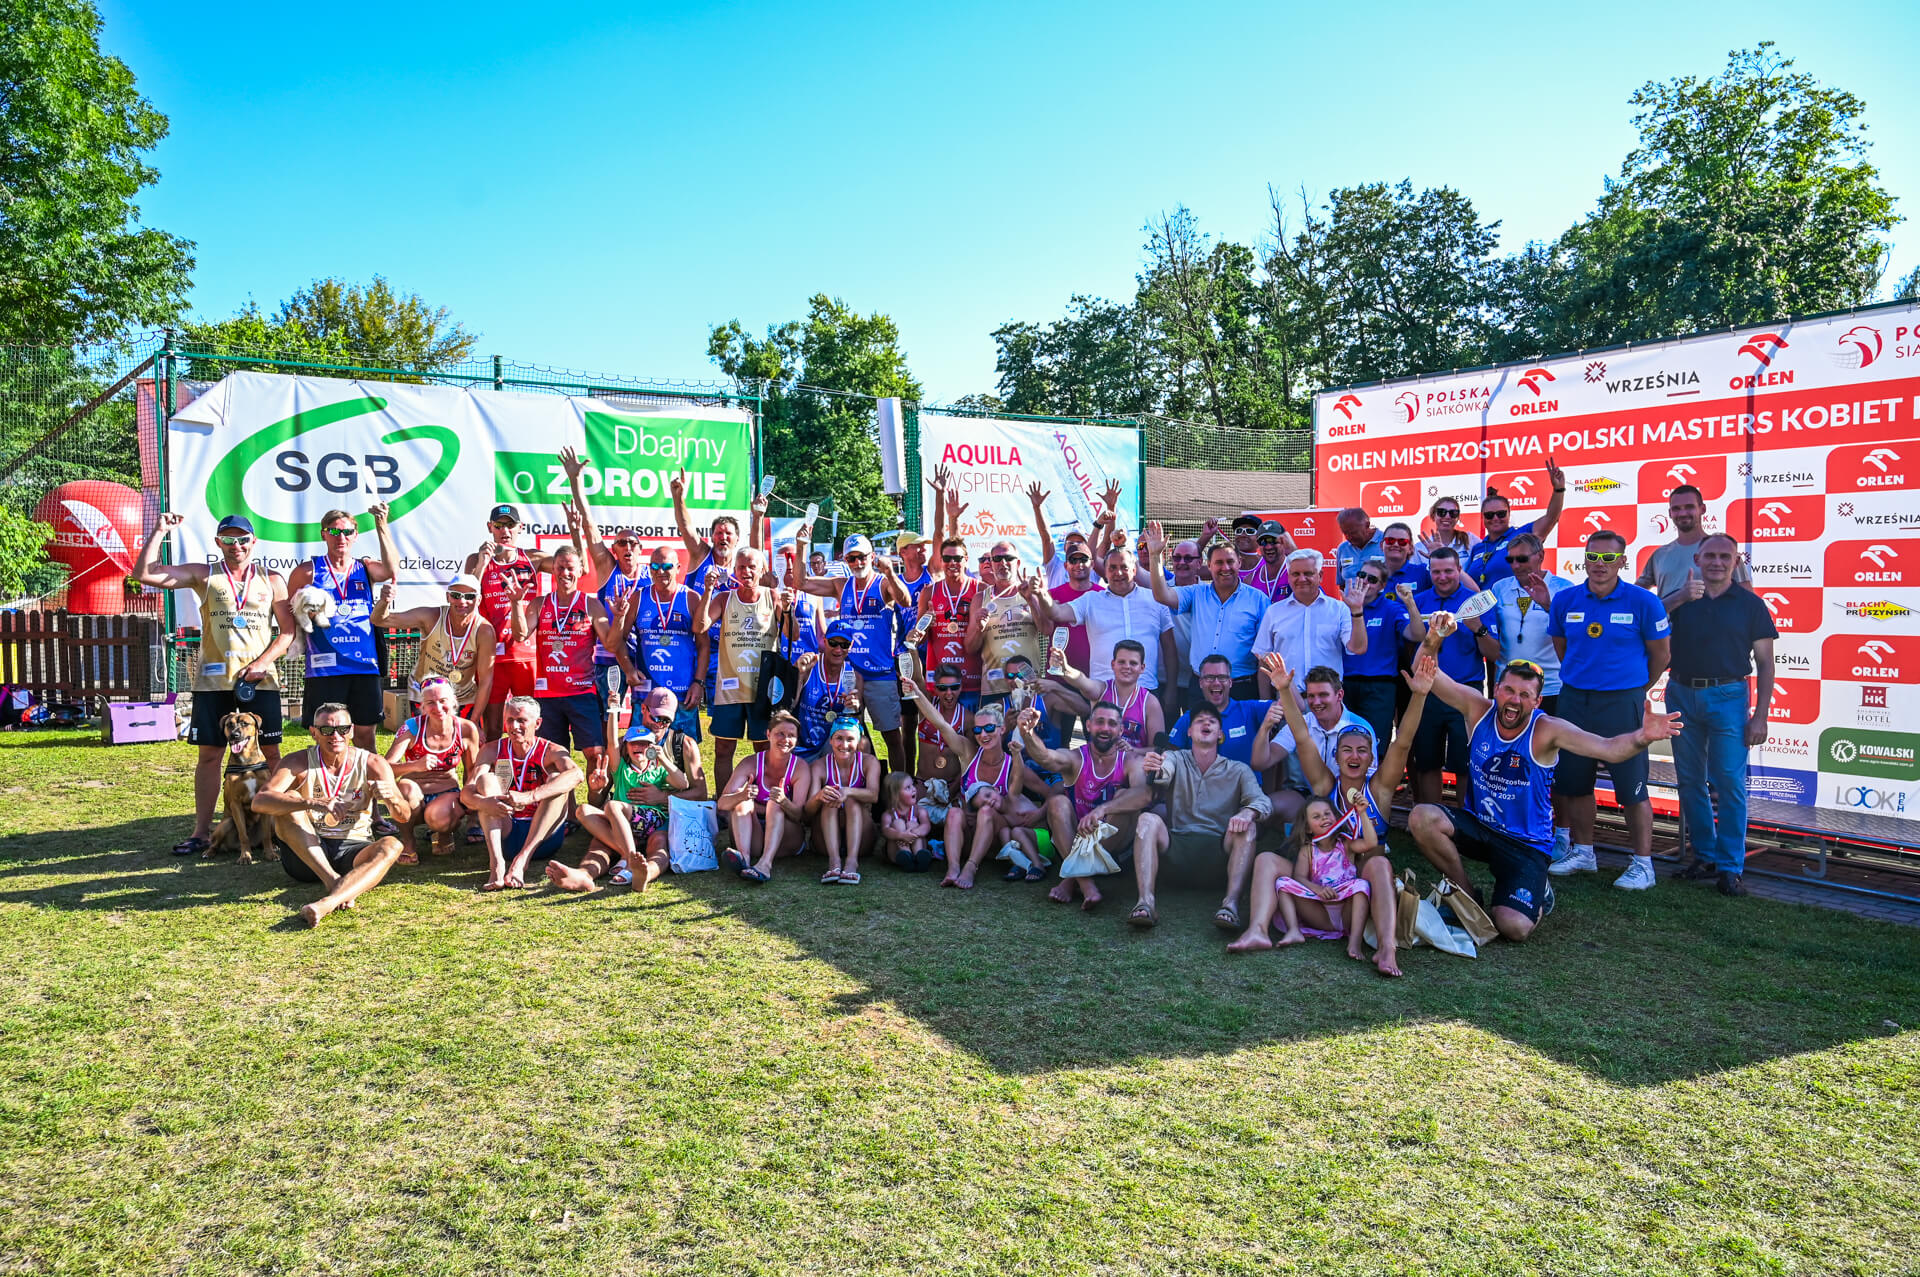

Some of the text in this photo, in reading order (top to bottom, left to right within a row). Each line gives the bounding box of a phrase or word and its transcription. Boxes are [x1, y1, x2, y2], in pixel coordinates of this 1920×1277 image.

[1606, 370, 1700, 394] WRZEŚNIA
[1729, 369, 1794, 390] ORLEN
[1426, 386, 1491, 405] POLSKA
[1426, 399, 1491, 417] SIATKÓWKA
[1510, 399, 1559, 416] ORLEN
[1328, 423, 1366, 437] ORLEN
[1328, 450, 1386, 472] ORLEN
[1391, 435, 1543, 467] MISTRZOSTWA
[1549, 424, 1635, 454] POLSKI
[1642, 411, 1774, 445] MASTERS
[1781, 397, 1904, 432] KOBIET
[614, 424, 727, 467] Dbajmy
[942, 443, 1023, 466] AQUILA
[275, 450, 402, 495] SGB
[1052, 430, 1103, 518] AQUILA
[1752, 472, 1815, 484] WRZEŚNIA
[948, 471, 1025, 494] WSPIERA
[1574, 477, 1605, 485] BLACHY
[1856, 474, 1905, 487] ORLEN
[1377, 504, 1404, 514] ORLEN
[1854, 512, 1920, 525] WRZEŚNIA
[1753, 527, 1796, 538] ORLEN
[55, 534, 95, 546] RLEN
[1751, 563, 1812, 574] WRZEŚNIA
[1854, 571, 1902, 582] ORLEN
[1003, 609, 1013, 621] 1
[744, 616, 753, 629] 2
[331, 635, 361, 644] ORLEN
[1774, 653, 1810, 665] EŚNIA
[545, 665, 570, 673] ORLEN
[736, 665, 761, 673] ORLEN
[1851, 666, 1899, 678] ORLEN
[821, 696, 830, 709] 2
[1864, 695, 1885, 705] HK
[1857, 713, 1889, 723] HOTEL
[1767, 737, 1809, 748] OLSKA
[1859, 744, 1915, 759] KOWALSKI
[1489, 756, 1502, 773] 2
[1488, 774, 1531, 787] Mistrzostwa
[1497, 792, 1516, 801] 2023
[1835, 786, 1896, 811] LOOK
